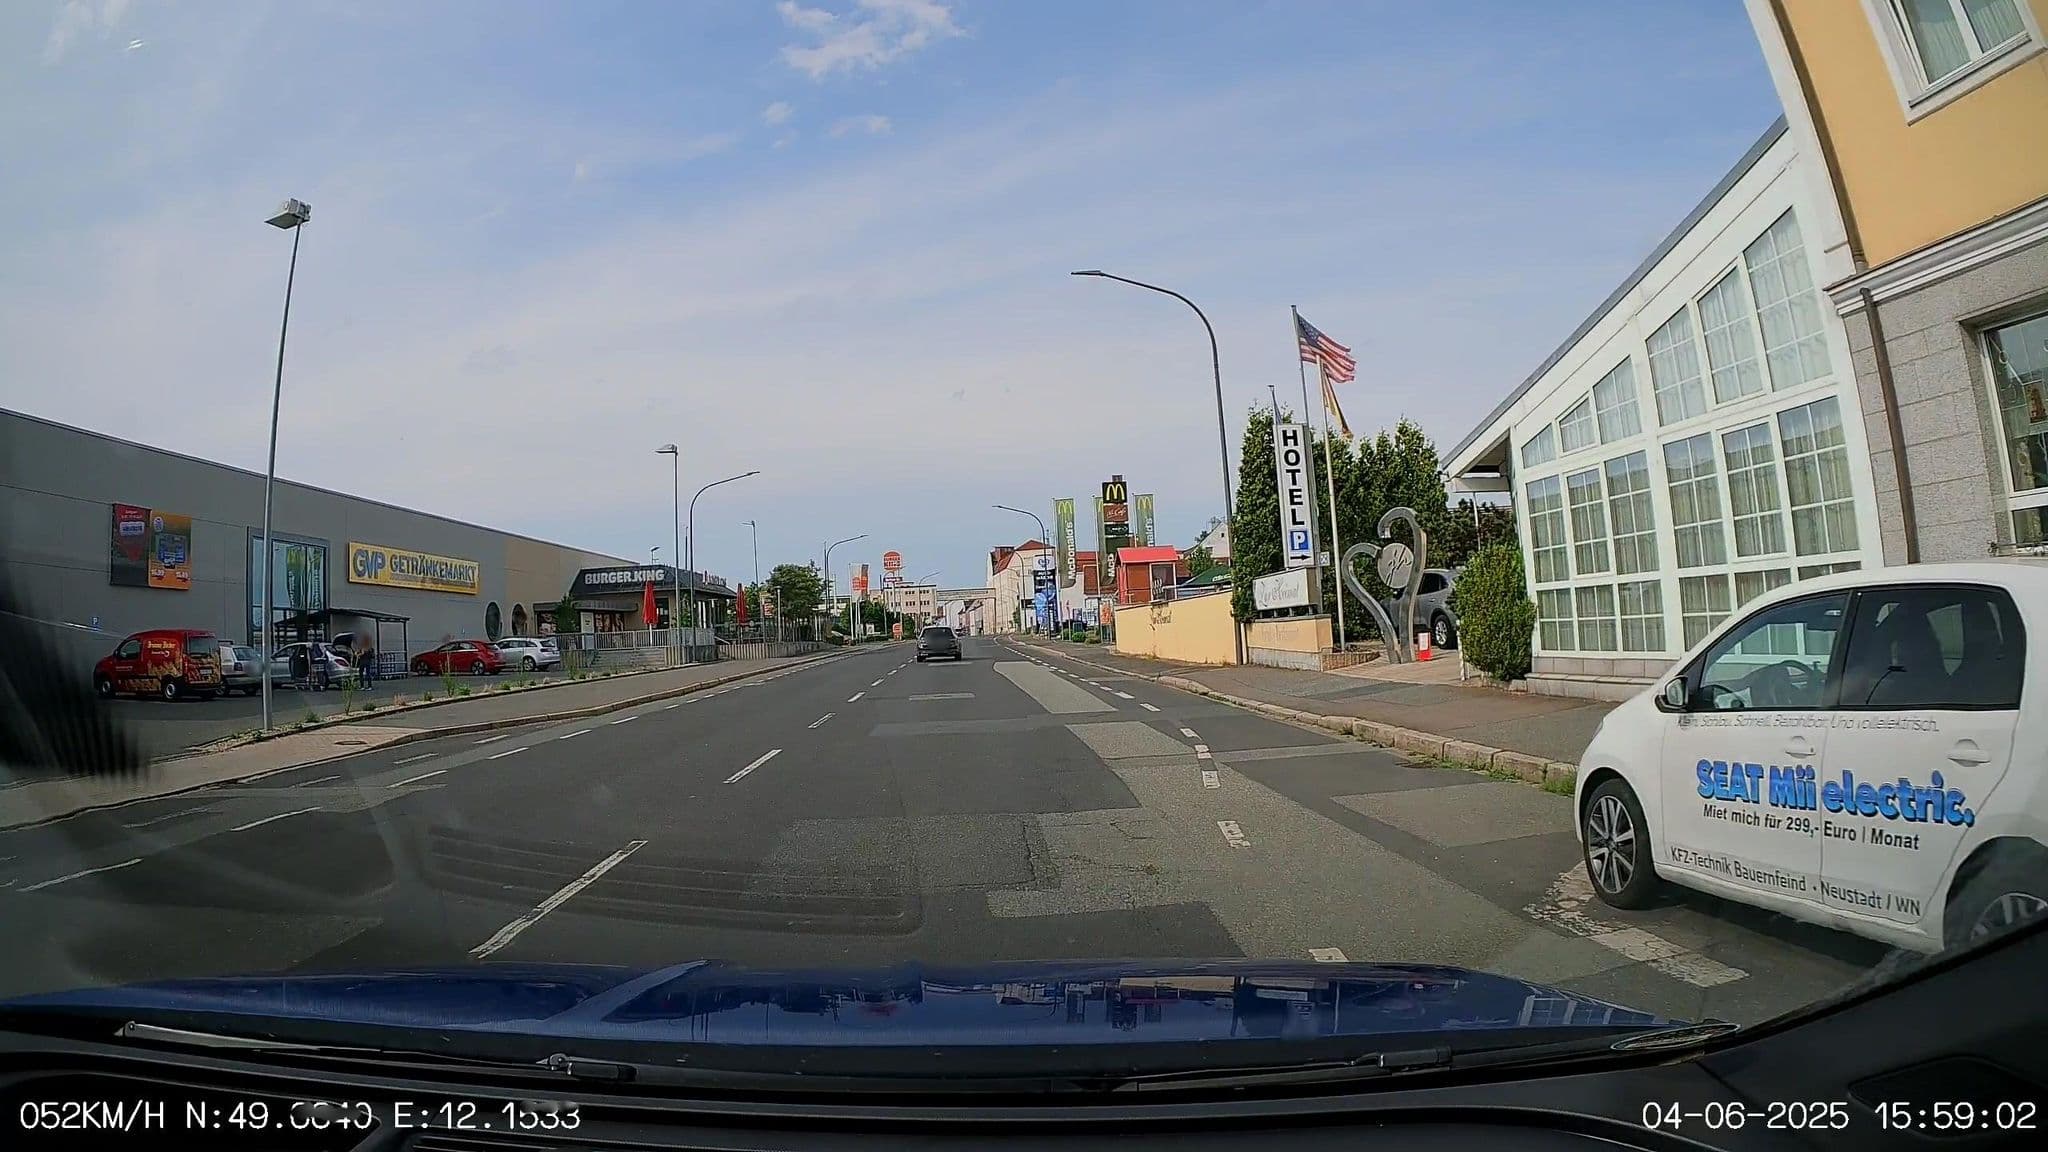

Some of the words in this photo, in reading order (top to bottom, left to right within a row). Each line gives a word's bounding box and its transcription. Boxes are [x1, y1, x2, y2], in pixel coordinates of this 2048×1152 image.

[1282, 430, 1305, 525] HOTEL
[1293, 531, 1306, 550] P
[353, 548, 386, 579] GVP
[390, 553, 477, 583] GETRÄNKEMARKT
[585, 571, 633, 584] BURGER
[634, 569, 665, 583] KING
[1697, 759, 1764, 804] SEAT
[1769, 764, 1817, 811] Mii
[1821, 770, 1975, 828] electric.
[1703, 803, 1727, 820] Miet
[1731, 809, 1760, 827] mich
[1765, 813, 1782, 829] für
[1786, 816, 1819, 838] 299,-
[1824, 820, 1857, 841] Euro
[1871, 827, 1920, 850] Monat
[1670, 845, 1733, 876] KFZ-Technik
[1734, 859, 1807, 891] Bauernfeind
[1820, 879, 1882, 909] Neustadt
[1896, 895, 1920, 916] WN
